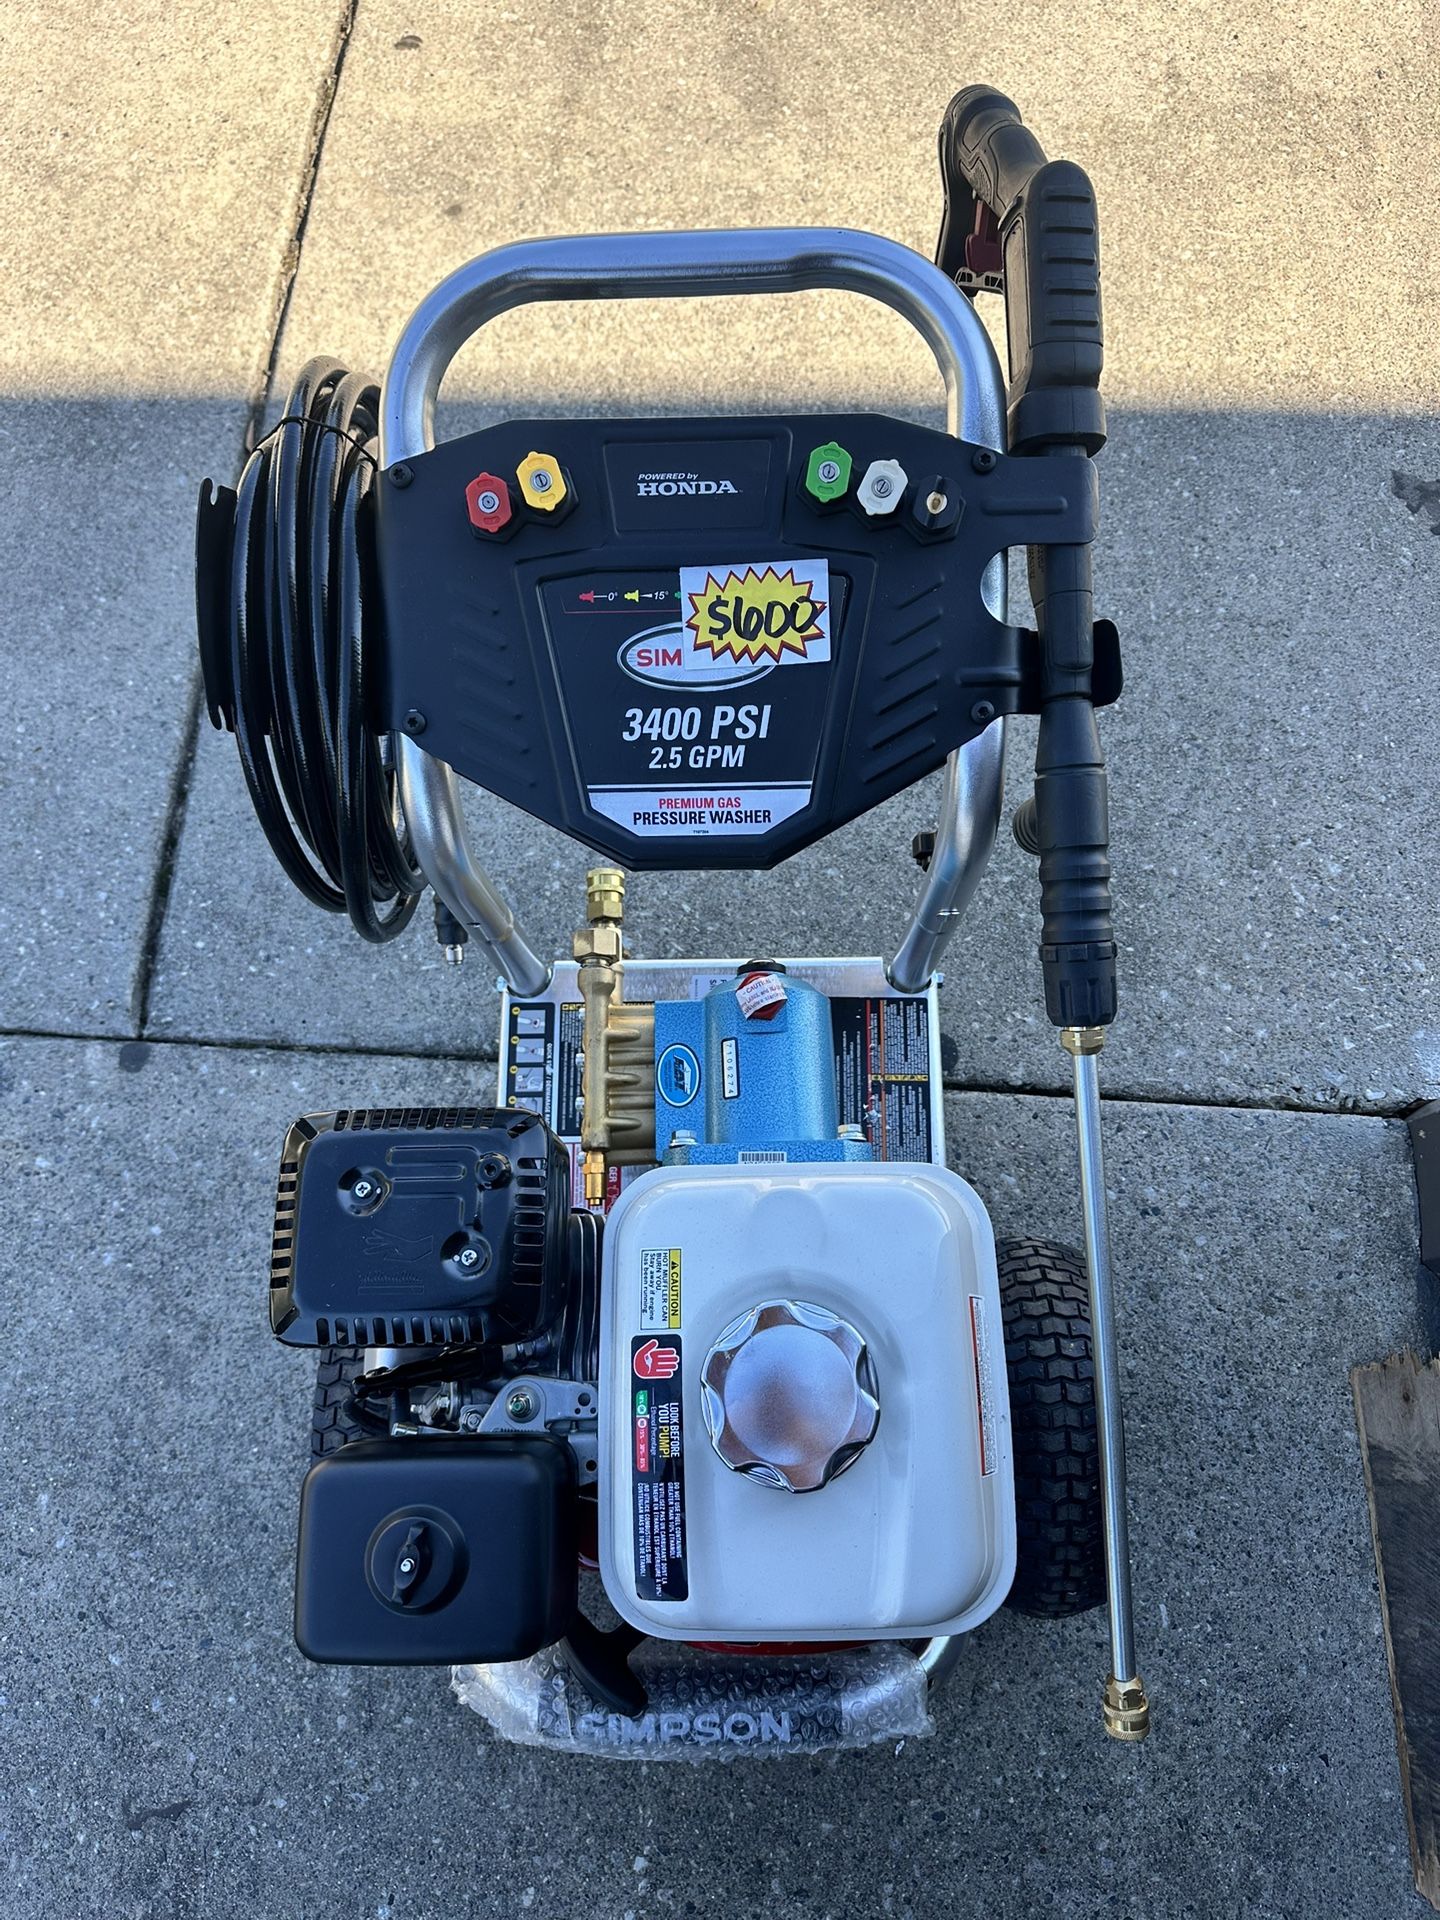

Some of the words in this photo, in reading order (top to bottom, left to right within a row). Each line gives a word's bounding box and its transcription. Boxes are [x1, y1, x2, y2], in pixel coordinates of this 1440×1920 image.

[637, 481, 738, 496] HONDA
[708, 595, 818, 641] $600
[622, 707, 702, 741] 3400
[710, 705, 771, 739] PSI
[649, 747, 682, 768] 2.5
[689, 745, 746, 768] GPM
[658, 798, 714, 809] PREMIUM
[718, 797, 741, 808] GAS
[633, 811, 706, 825] PRESSURE
[710, 810, 771, 824] WASHER
[609, 1166, 617, 1182] GER
[659, 1403, 669, 1423] YOU
[670, 1402, 679, 1424] LOOK
[659, 1426, 670, 1458] PUMP!
[670, 1425, 680, 1458] BEFORE
[576, 1712, 791, 1743] SIMPSON
